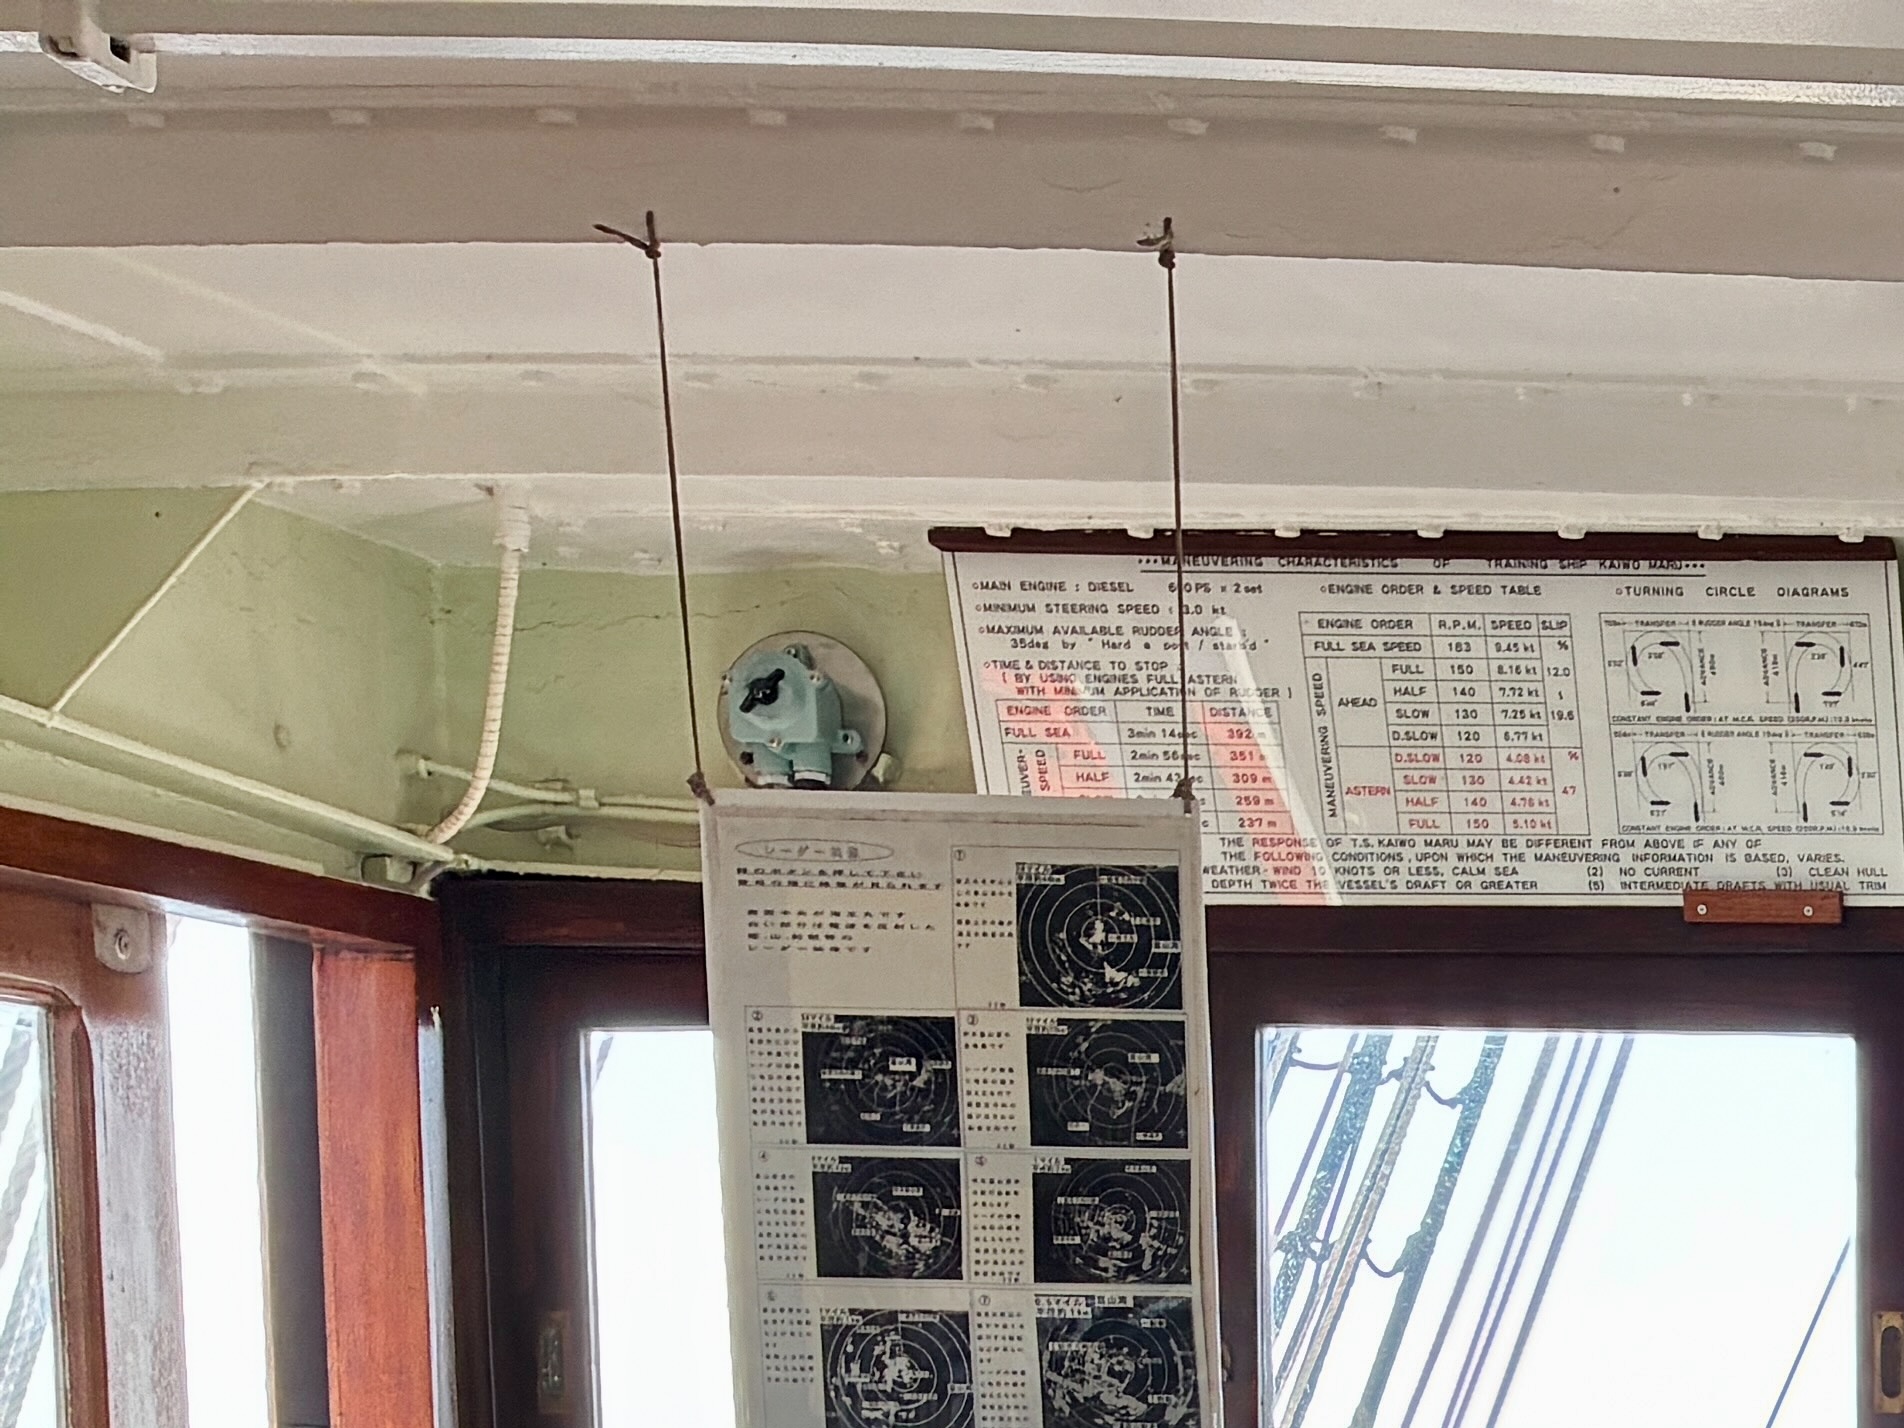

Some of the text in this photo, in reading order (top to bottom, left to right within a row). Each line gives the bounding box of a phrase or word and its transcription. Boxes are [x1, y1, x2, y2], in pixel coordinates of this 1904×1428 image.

[980, 581, 1134, 593] MAIN ENGINE DIESEL
[1328, 584, 1542, 596] ENGINE ORDER SPEED TABLE
[1625, 587, 1850, 598] TURNING CIRCLE DIAGRAMS
[983, 603, 1160, 614] MINIMUM STEERING SPEED
[1317, 618, 1568, 630] ENGINE ORDER R.P.M. SPEED SLIP
[986, 625, 1123, 636] MAXIMUM AVAILABLE
[1314, 641, 1344, 651] FULL
[1352, 641, 1376, 651] SEA
[1383, 642, 1422, 652] SPEED
[991, 660, 1168, 671] TIME DISTANCE STOP
[1392, 664, 1473, 675] FULL 150
[1394, 686, 1476, 697] HALF 140
[1338, 697, 1378, 708] AHEAD
[1396, 709, 1478, 719] SLOW 130
[1392, 731, 1480, 742] D.SLOW 120
[1395, 753, 1482, 763] D.SLOW 120
[1403, 775, 1485, 785] SLOW 130
[1345, 786, 1391, 796] ASTERN
[1405, 797, 1487, 807] HALF 140
[1408, 819, 1489, 830] FULL 150
[1377, 839, 1685, 849] KAIWO MARU DIFFERENT FROM ABOVE
[1456, 852, 1713, 863] WHICH MANEUVERING INFORMATION
[1452, 867, 1519, 877] CALM SEA
[1644, 867, 1699, 877] CURRENT
[1808, 867, 1888, 877] CLEAN HULL
[1211, 879, 1537, 890] DEPTH DRAFT GREATER
